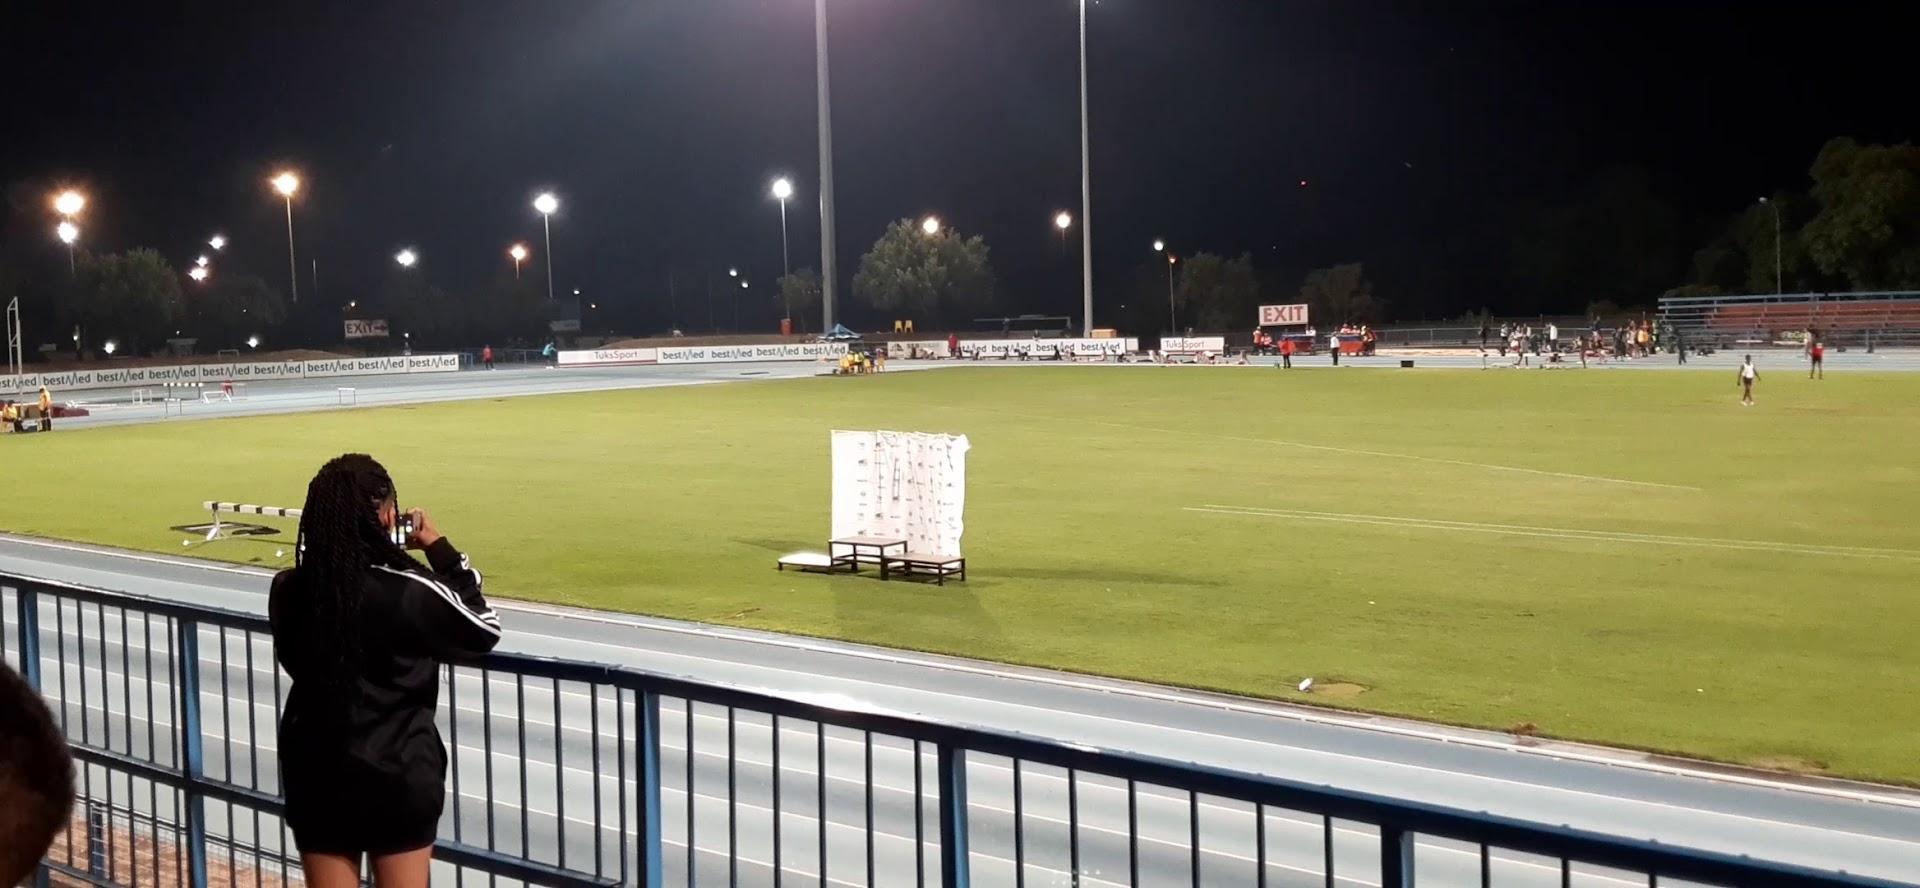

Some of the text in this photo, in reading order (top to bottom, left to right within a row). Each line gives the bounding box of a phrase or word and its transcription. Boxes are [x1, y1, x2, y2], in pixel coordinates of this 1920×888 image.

[1263, 306, 1304, 322] EXIT
[346, 323, 372, 334] EXIT
[594, 350, 638, 360] TuksSport
[662, 344, 846, 361] bestMed bestMed bestMed bestMed
[43, 371, 91, 386] bestMed
[97, 369, 144, 384] bestMed
[149, 366, 196, 381] bestMed
[203, 363, 250, 378] bestMed
[254, 362, 301, 376] bestMed
[307, 360, 354, 373] bestMed
[358, 357, 404, 371] bestMed
[409, 355, 456, 368] bestMed
